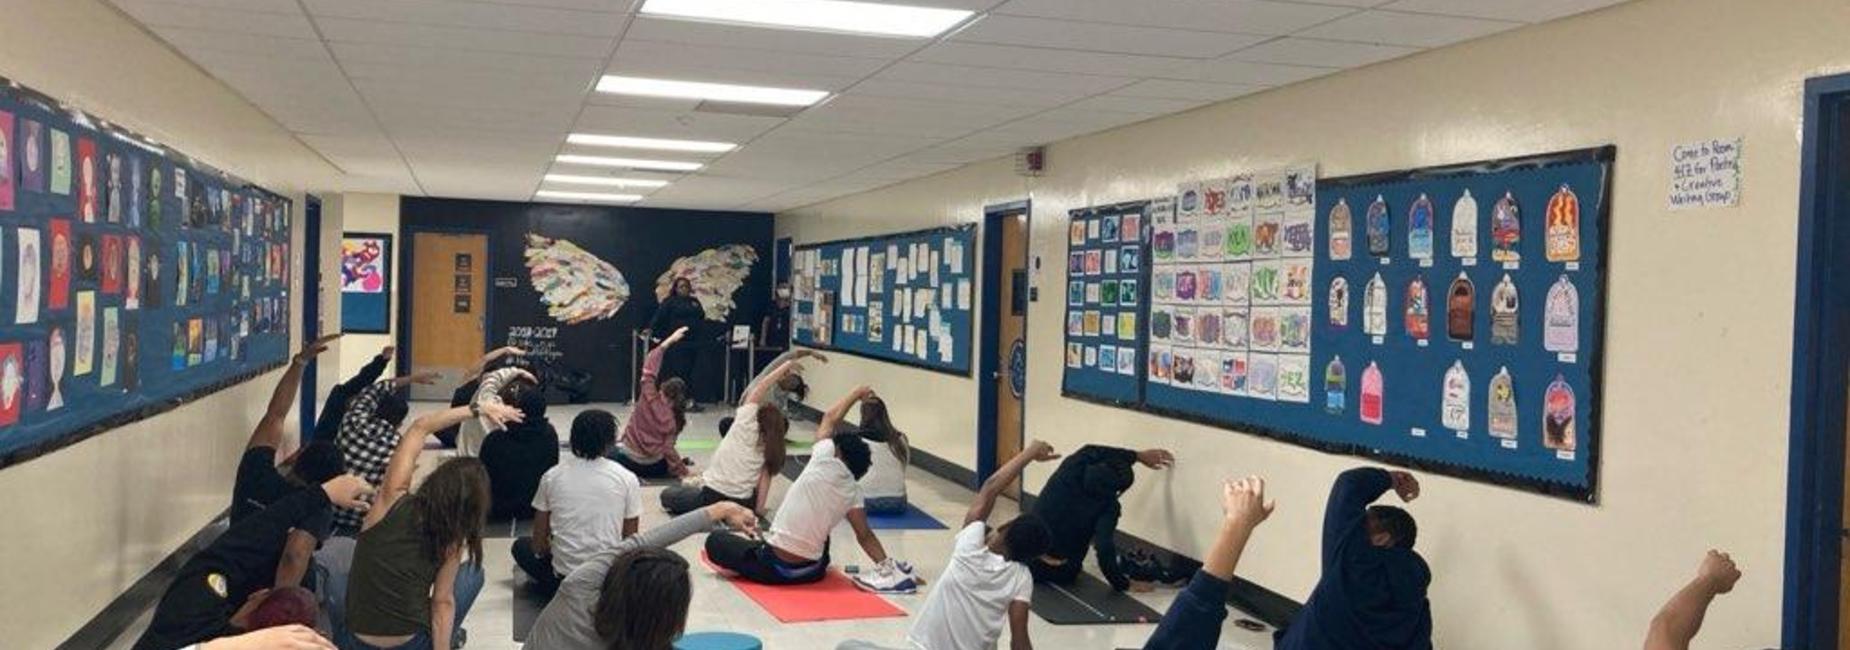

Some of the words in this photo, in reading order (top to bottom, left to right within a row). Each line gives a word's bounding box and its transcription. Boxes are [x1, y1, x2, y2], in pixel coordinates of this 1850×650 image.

[1673, 145, 1698, 162] Come
[1701, 142, 1710, 156] to
[1712, 139, 1734, 154] Room
[1669, 193, 1705, 206] Writing
[1705, 190, 1731, 204] Group
